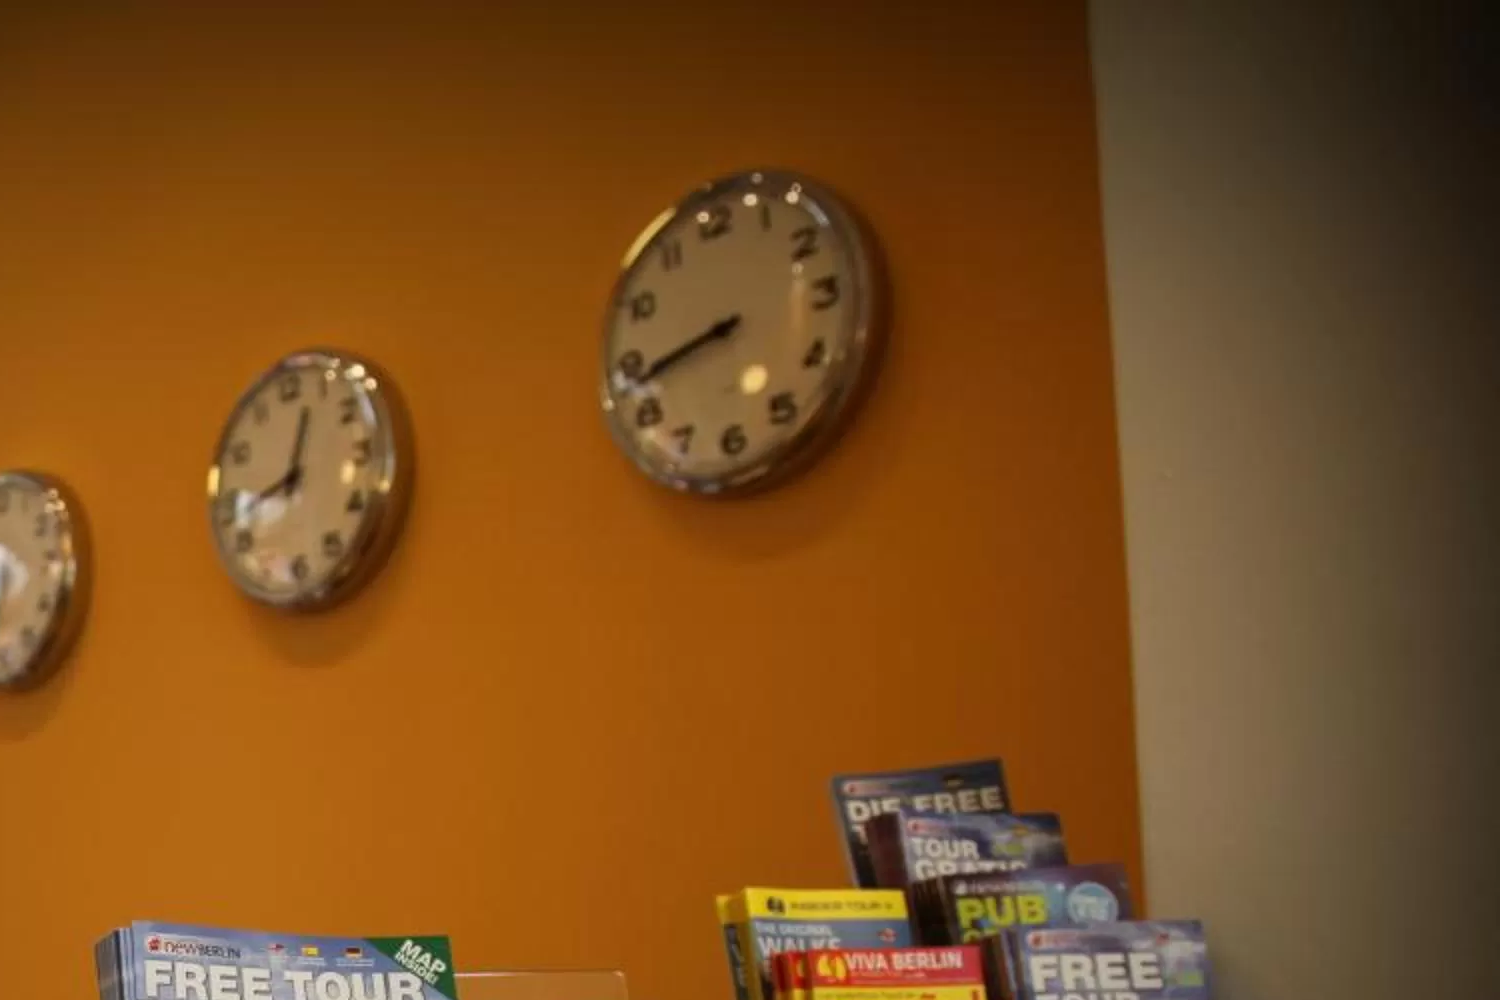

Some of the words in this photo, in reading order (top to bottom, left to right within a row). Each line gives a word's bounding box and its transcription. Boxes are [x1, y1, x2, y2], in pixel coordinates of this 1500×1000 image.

[721, 424, 747, 455] 6
[913, 786, 1004, 813] FREE
[911, 837, 979, 860] TOUR
[956, 894, 1049, 929] PUB
[394, 952, 440, 986] INSIDE!
[399, 939, 446, 977] MAP
[845, 952, 889, 971] VIVA
[894, 951, 964, 970] BERLIN
[1029, 952, 1164, 993] FREE
